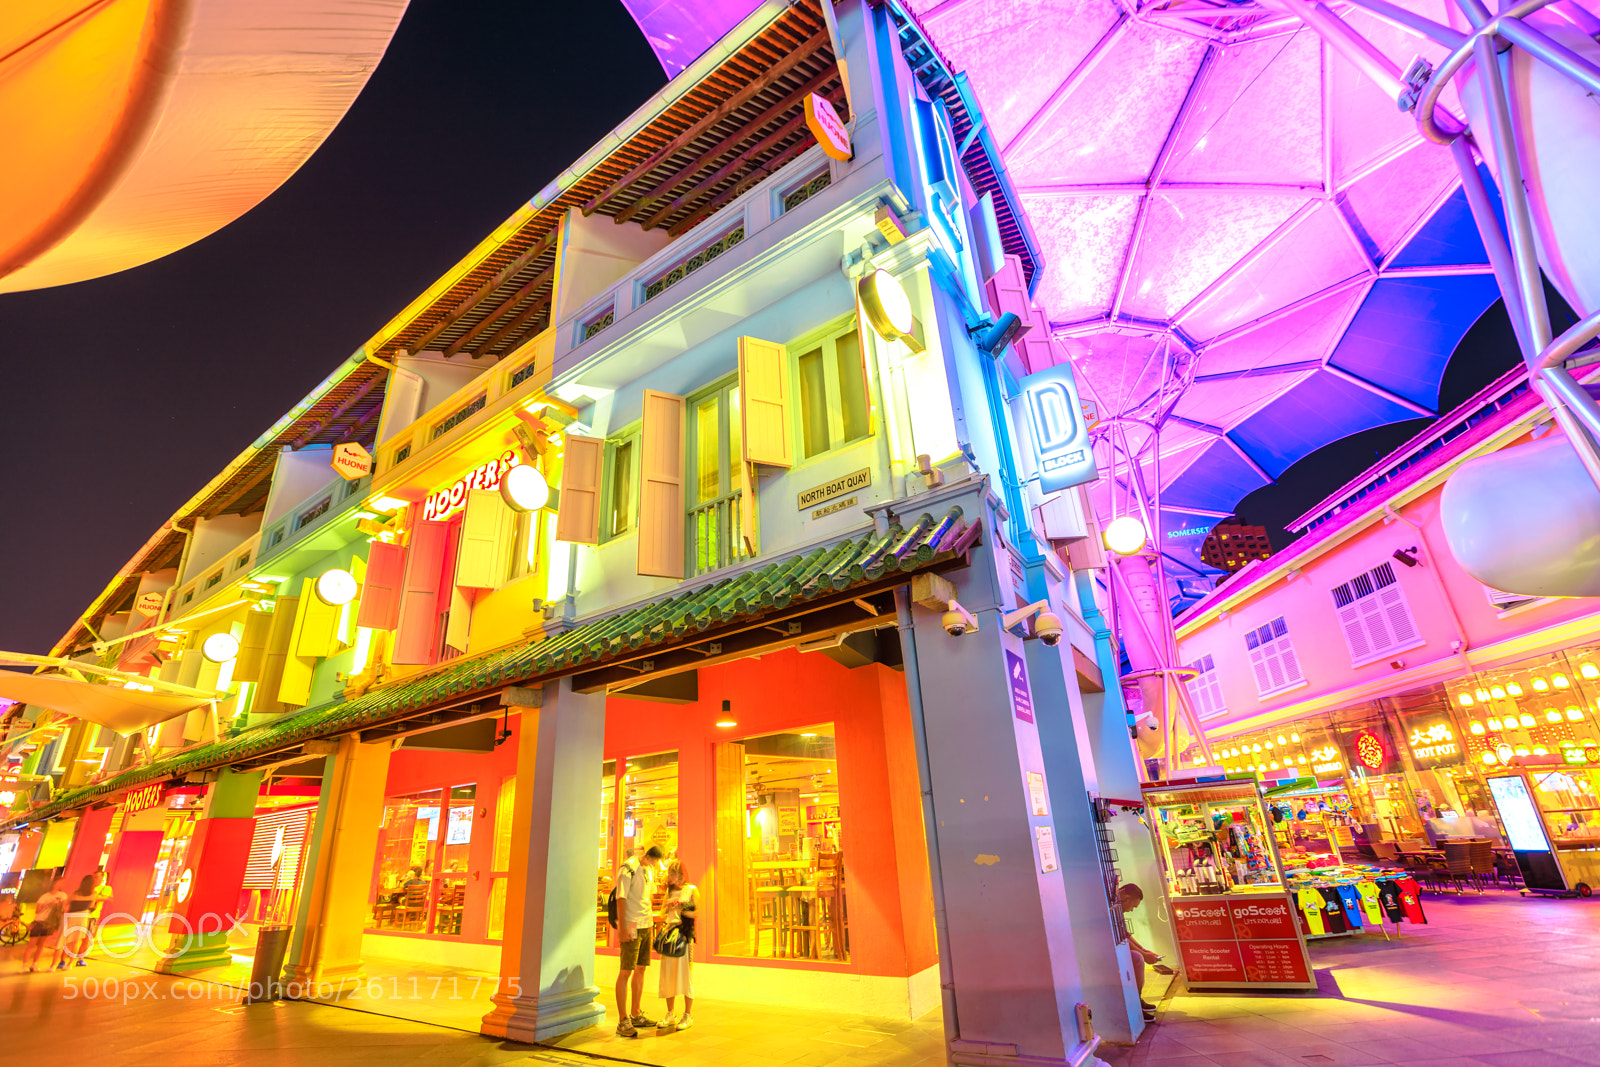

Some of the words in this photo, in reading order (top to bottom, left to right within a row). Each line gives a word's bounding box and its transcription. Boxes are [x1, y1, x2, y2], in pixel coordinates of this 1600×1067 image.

[817, 110, 849, 150] HUONE
[1026, 381, 1078, 455] D
[337, 456, 368, 472] HUONE
[1043, 450, 1085, 472] BLOCK
[423, 450, 516, 520] HOOTERS
[801, 488, 825, 505] NORTH
[826, 480, 845, 496] BOAT
[847, 472, 867, 488] QUAY
[1167, 526, 1210, 539] SOMERSET
[1413, 746, 1436, 759] HOT
[1435, 743, 1457, 756] POT
[124, 783, 163, 813] HOOTERS
[1176, 906, 1227, 921] goScoot
[1233, 904, 1288, 919] goScoot
